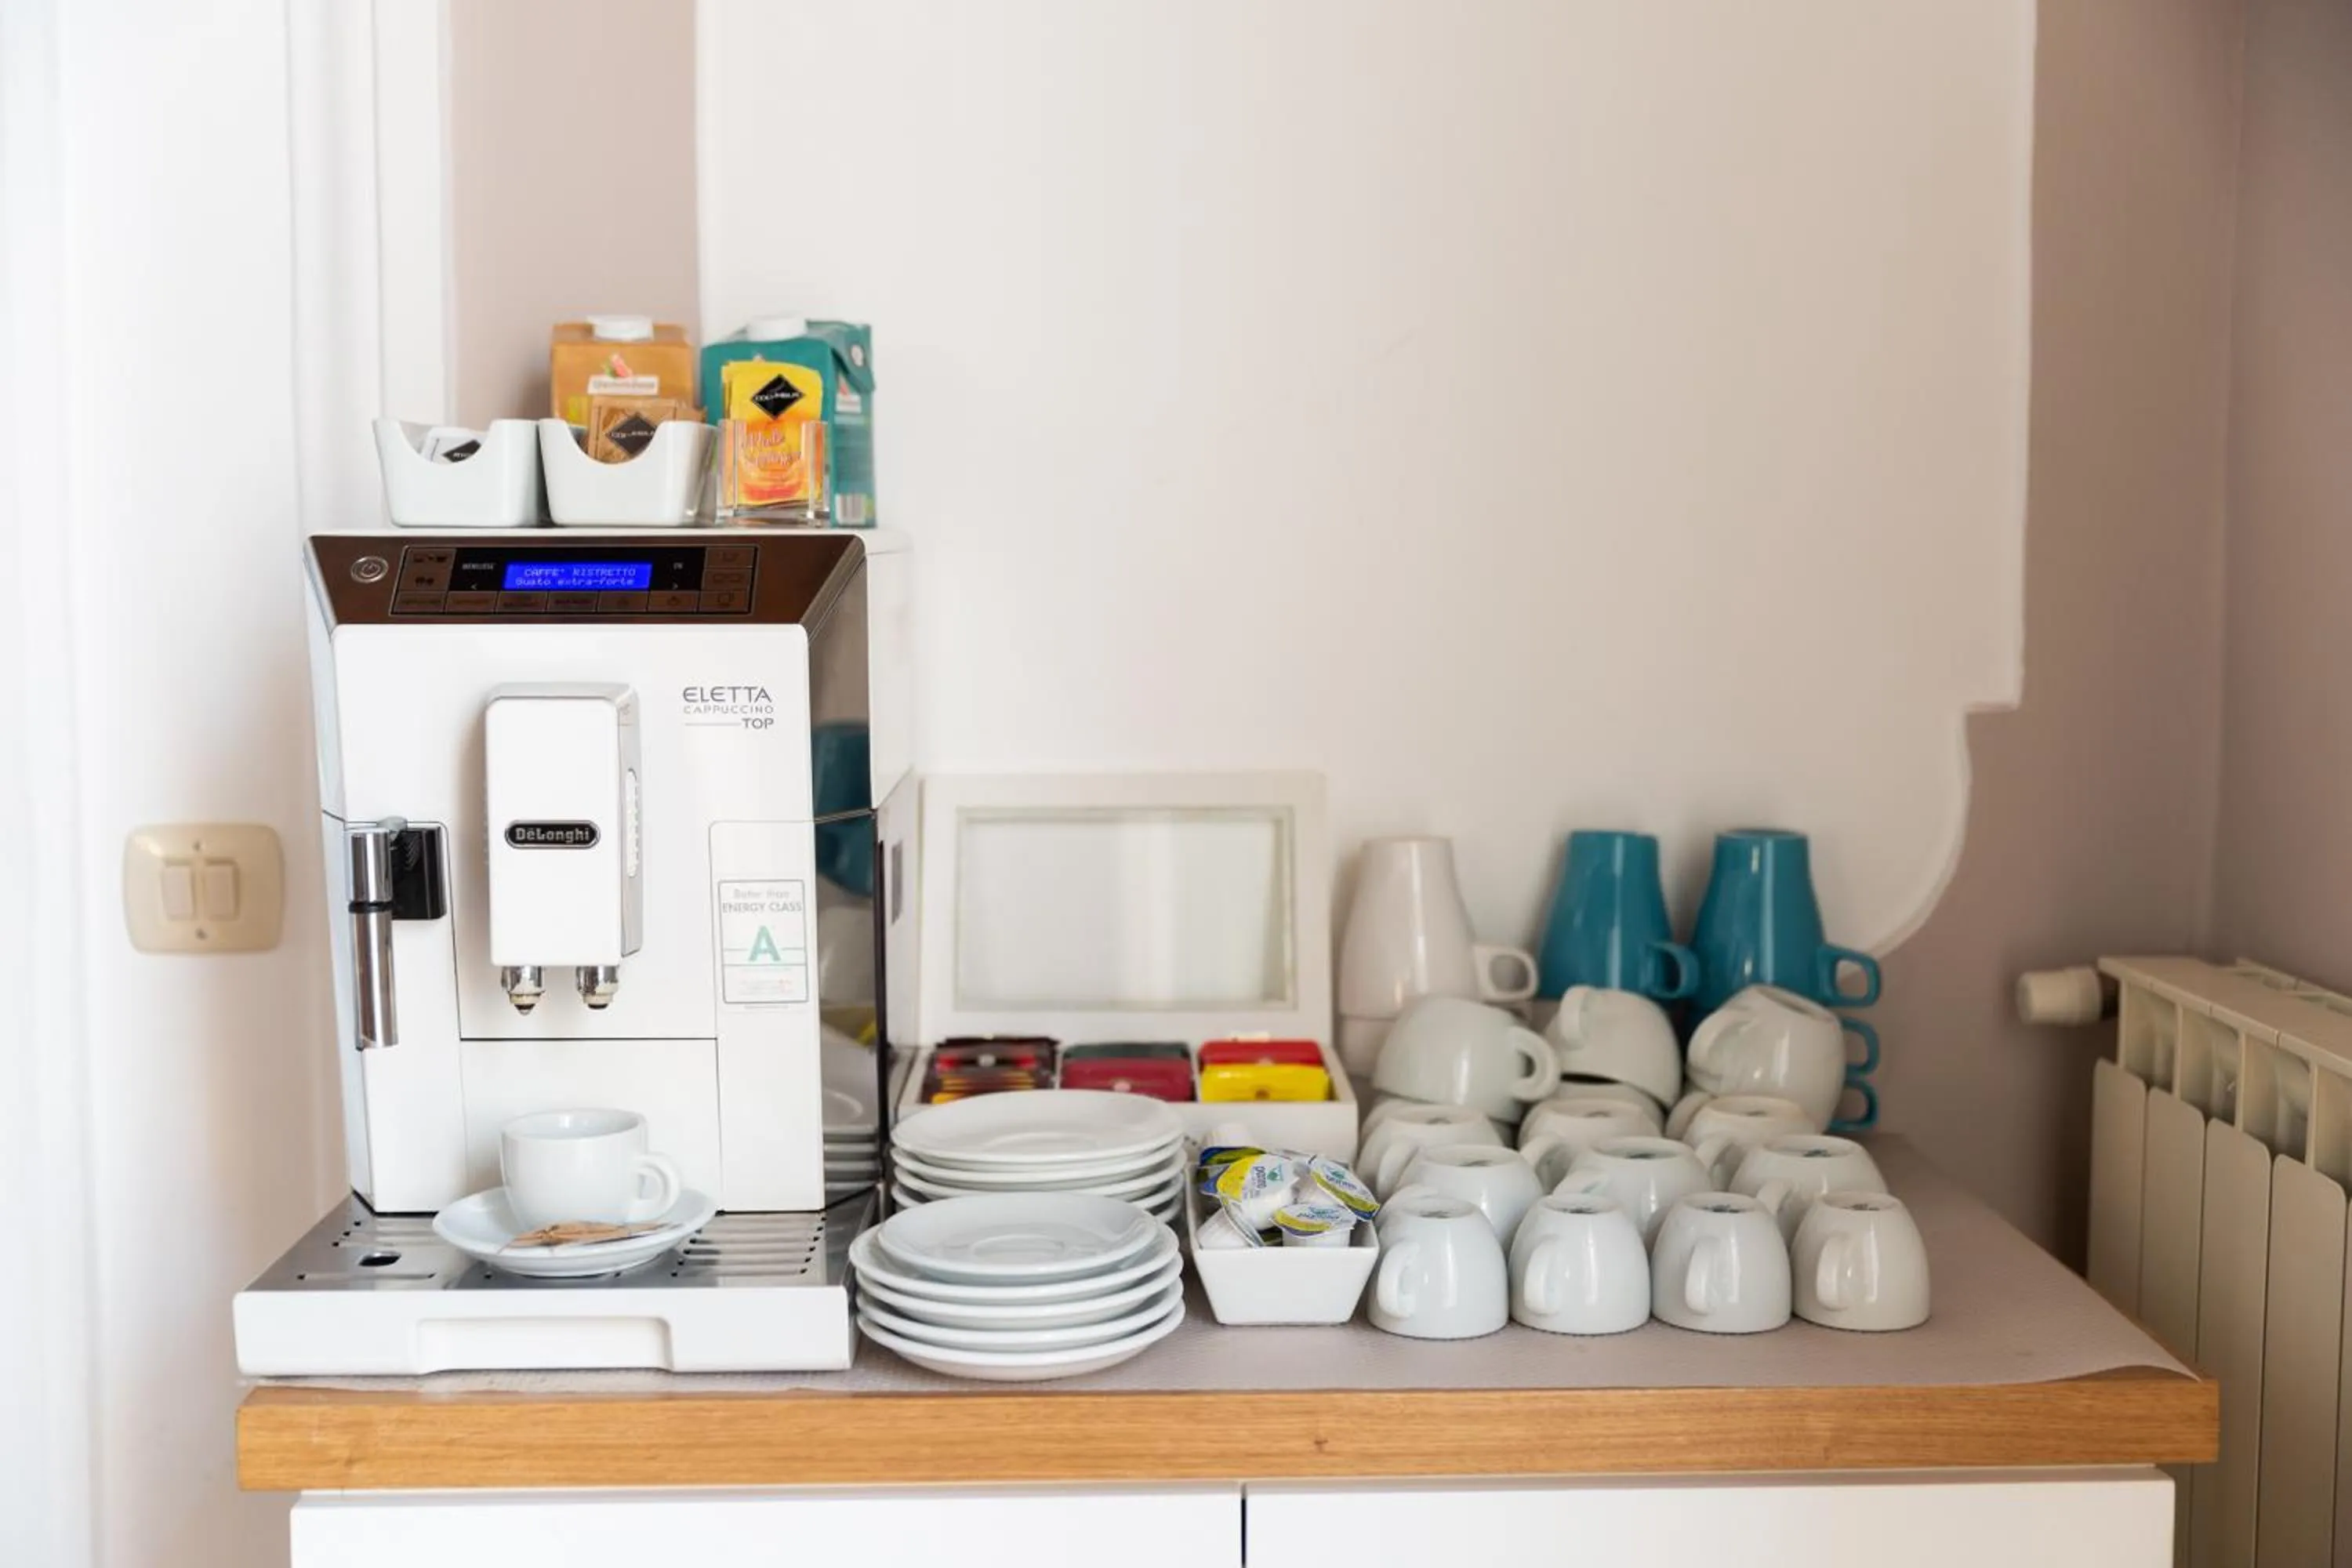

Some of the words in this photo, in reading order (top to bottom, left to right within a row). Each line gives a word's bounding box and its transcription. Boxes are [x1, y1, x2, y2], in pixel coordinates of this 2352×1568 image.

[573, 568, 637, 577] RISTRETTO
[683, 685, 772, 703] ELETTA
[683, 705, 774, 714] CAPPUCCINO
[741, 717, 775, 729] TOP
[722, 902, 765, 913] ENERGY
[768, 902, 803, 913] CLASS
[748, 924, 782, 962] A
